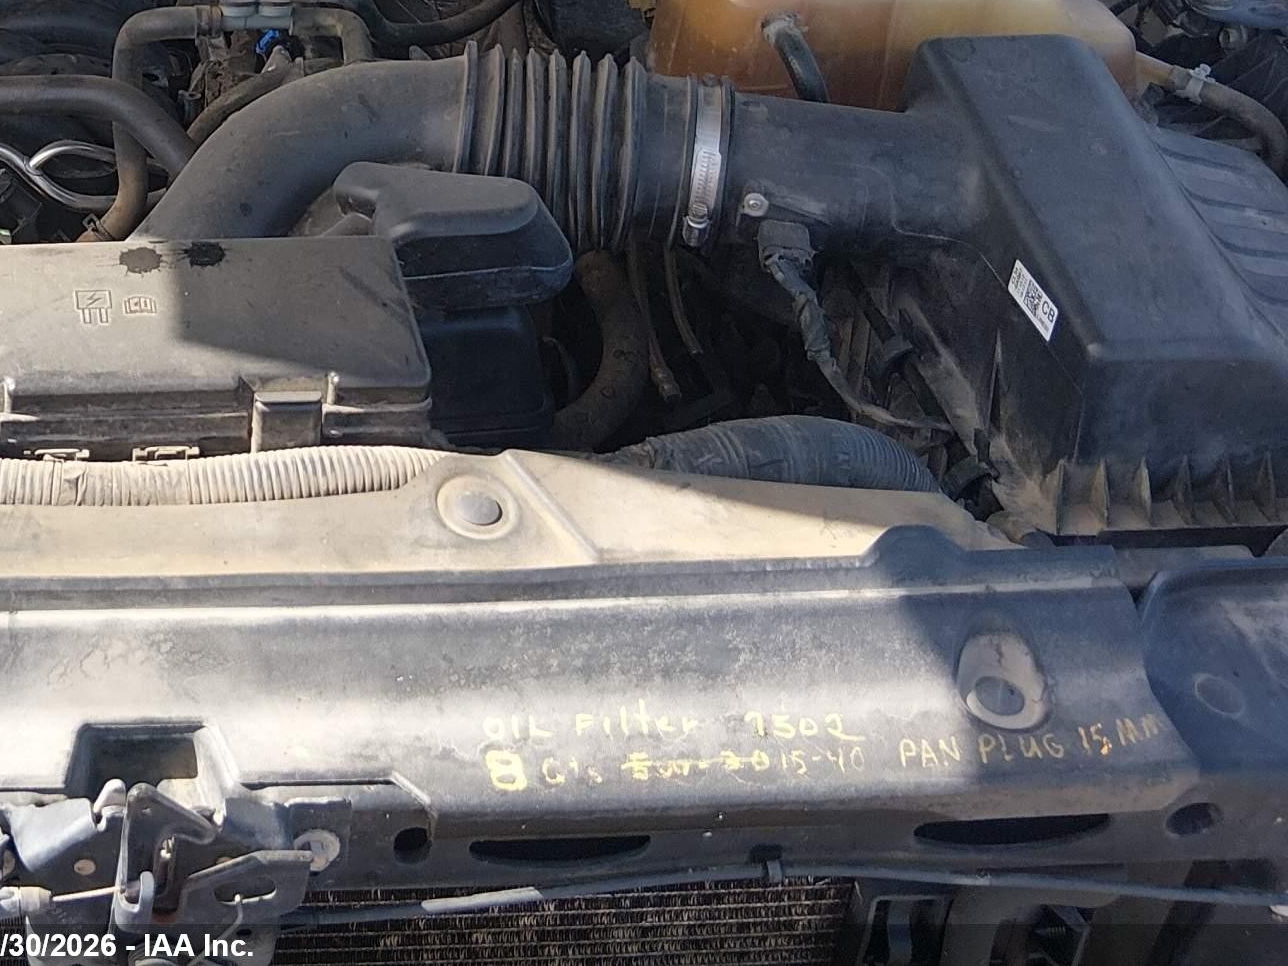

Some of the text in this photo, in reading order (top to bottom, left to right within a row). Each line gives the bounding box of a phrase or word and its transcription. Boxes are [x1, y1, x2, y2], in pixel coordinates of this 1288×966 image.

[1041, 301, 1055, 323] CB
[898, 736, 962, 768] PAN
[977, 732, 1065, 764] PLUG
[485, 749, 529, 791] 8
